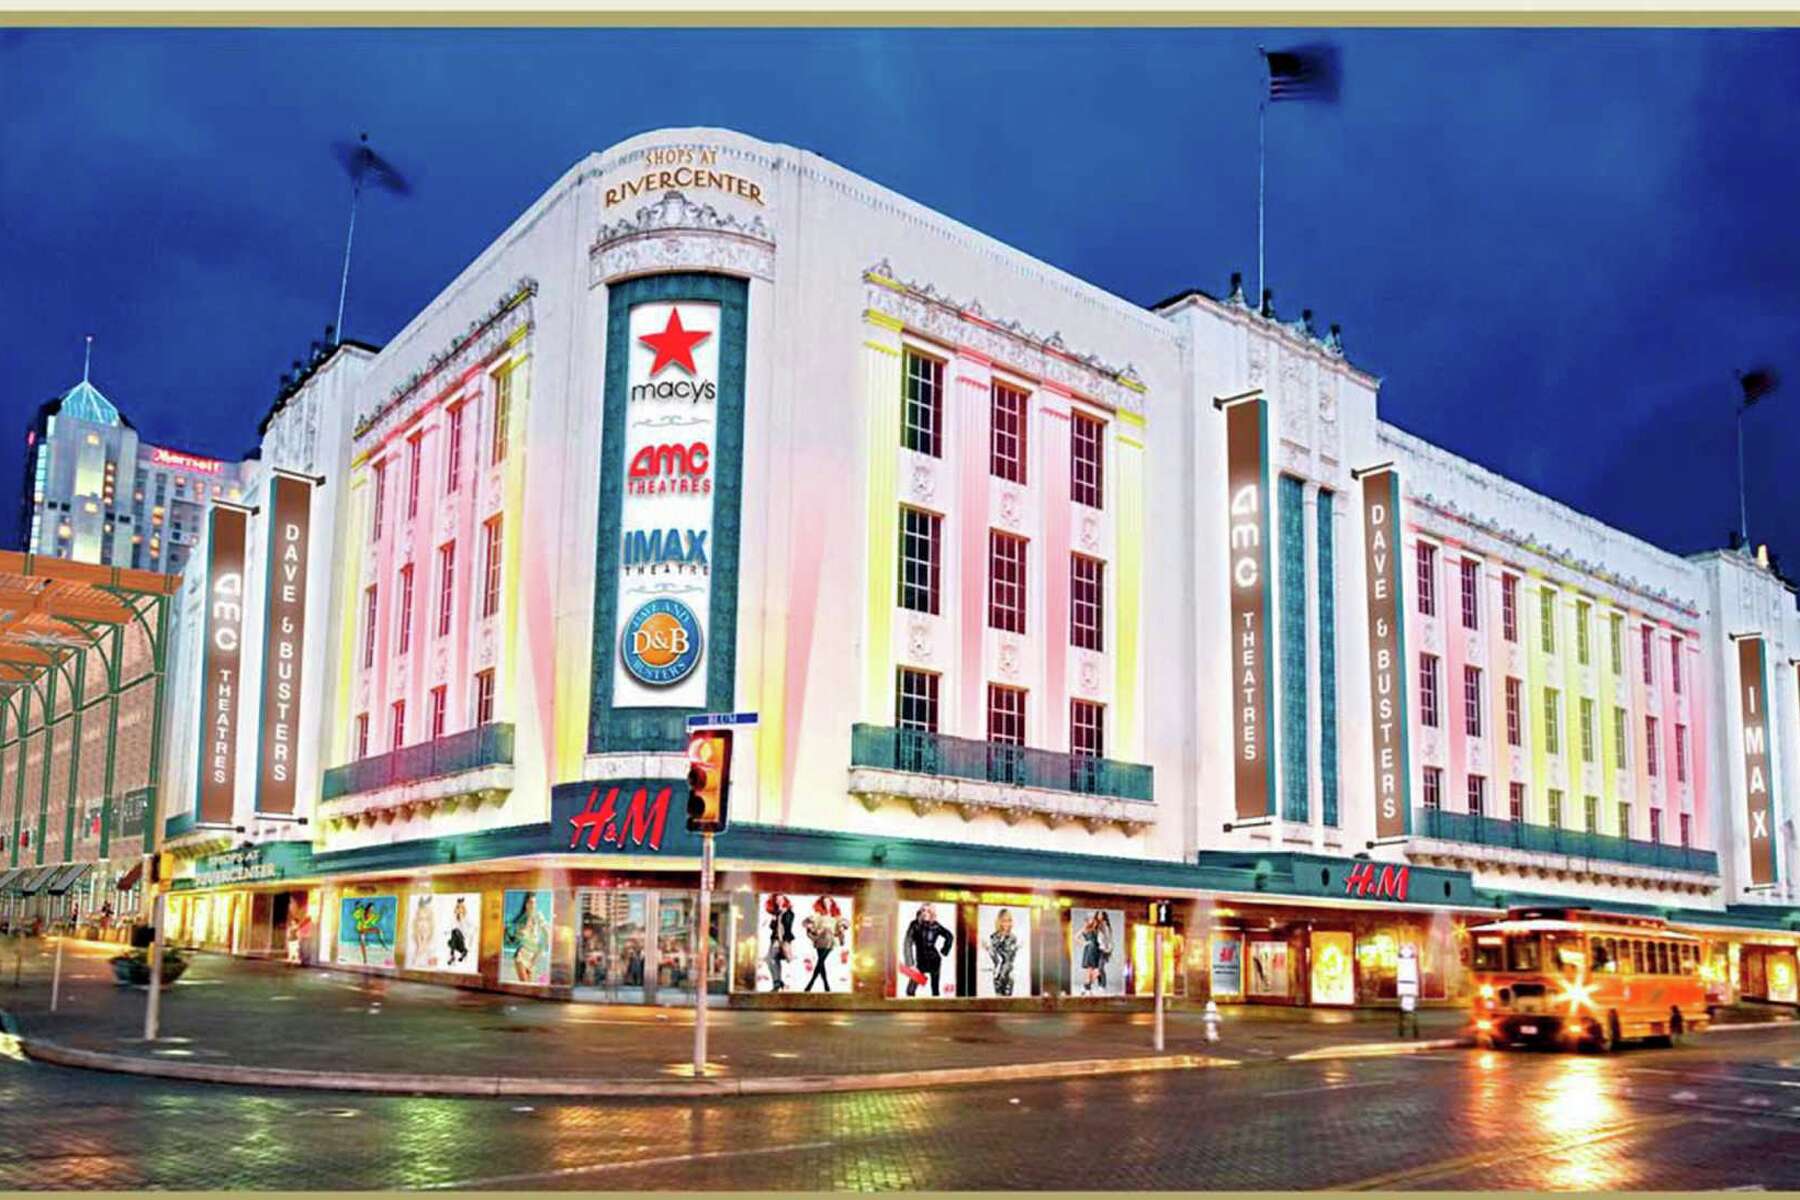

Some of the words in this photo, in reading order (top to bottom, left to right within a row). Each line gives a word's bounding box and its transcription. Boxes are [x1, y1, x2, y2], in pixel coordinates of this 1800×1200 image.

[646, 150, 693, 168] SHOPS
[701, 150, 717, 165] AT
[631, 379, 715, 404] macy's
[628, 479, 711, 495] THEATRES
[282, 524, 300, 603] DAVE
[623, 528, 709, 565] IMAX
[1371, 504, 1387, 600] DAVE
[624, 564, 709, 576] THEATRE
[282, 616, 294, 634] &
[632, 627, 690, 654] D&B
[1376, 617, 1388, 638] &
[1242, 612, 1256, 761] THEATRES
[214, 669, 233, 784] THEATRES
[274, 641, 294, 782] BUSTERS
[1377, 651, 1396, 819] BUSTERS
[1746, 686, 1768, 840] IMAX
[570, 786, 673, 851] H&M
[1344, 863, 1409, 900] H&M
